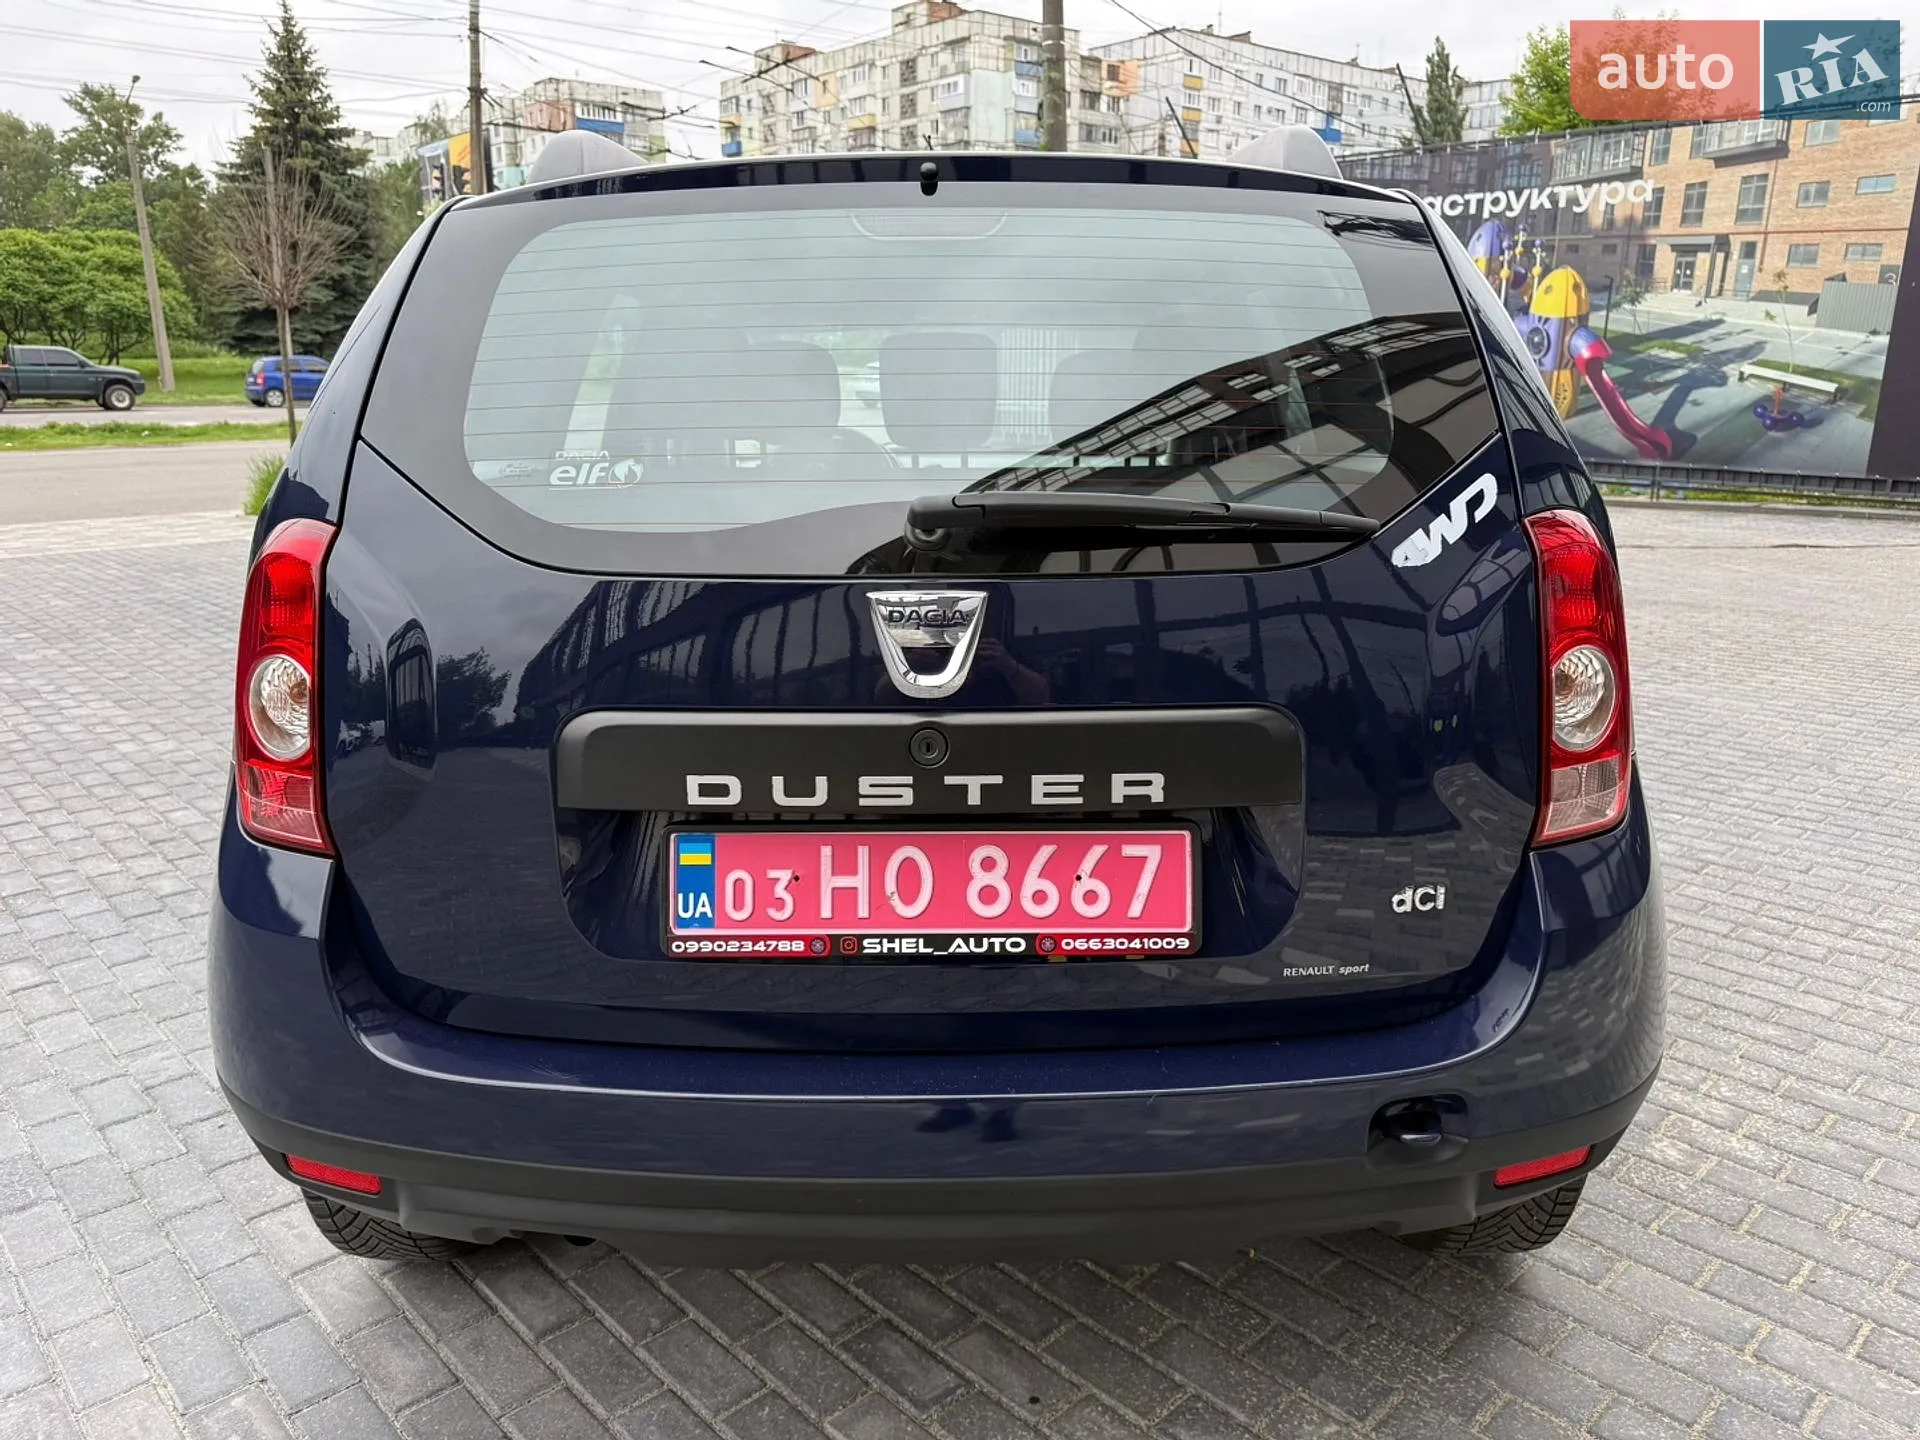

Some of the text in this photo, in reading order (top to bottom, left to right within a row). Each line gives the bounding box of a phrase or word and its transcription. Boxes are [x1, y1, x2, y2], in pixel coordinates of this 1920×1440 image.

[549, 462, 610, 486] elf
[887, 609, 967, 623] DACIA
[686, 773, 1165, 806] DUSTER
[724, 868, 796, 922] 03
[966, 844, 1163, 919] 8667
[677, 892, 713, 918] UA
[671, 940, 805, 953] 0990234788
[862, 937, 1027, 955] SHEL_AUTO
[1061, 937, 1190, 950] 0663041009
[1283, 963, 1370, 977] RENAULT sport
